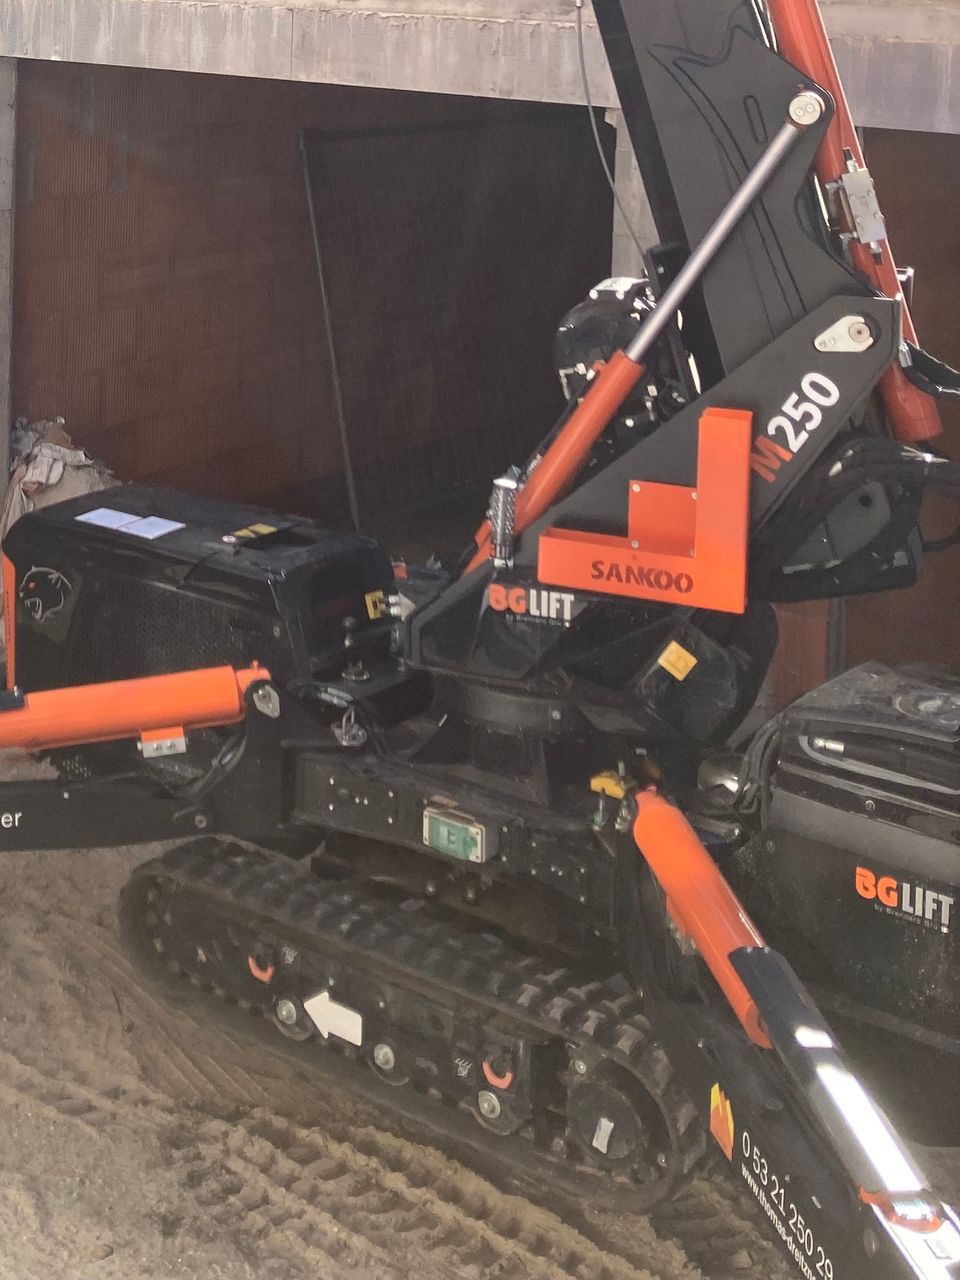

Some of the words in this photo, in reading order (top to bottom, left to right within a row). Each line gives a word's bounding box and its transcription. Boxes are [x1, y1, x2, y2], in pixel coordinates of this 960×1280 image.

[590, 559, 694, 594] SANKOO
[742, 1131, 751, 1158] 0
[752, 1146, 768, 1186] 53
[770, 1175, 786, 1217] 21
[788, 1203, 814, 1256] 250
